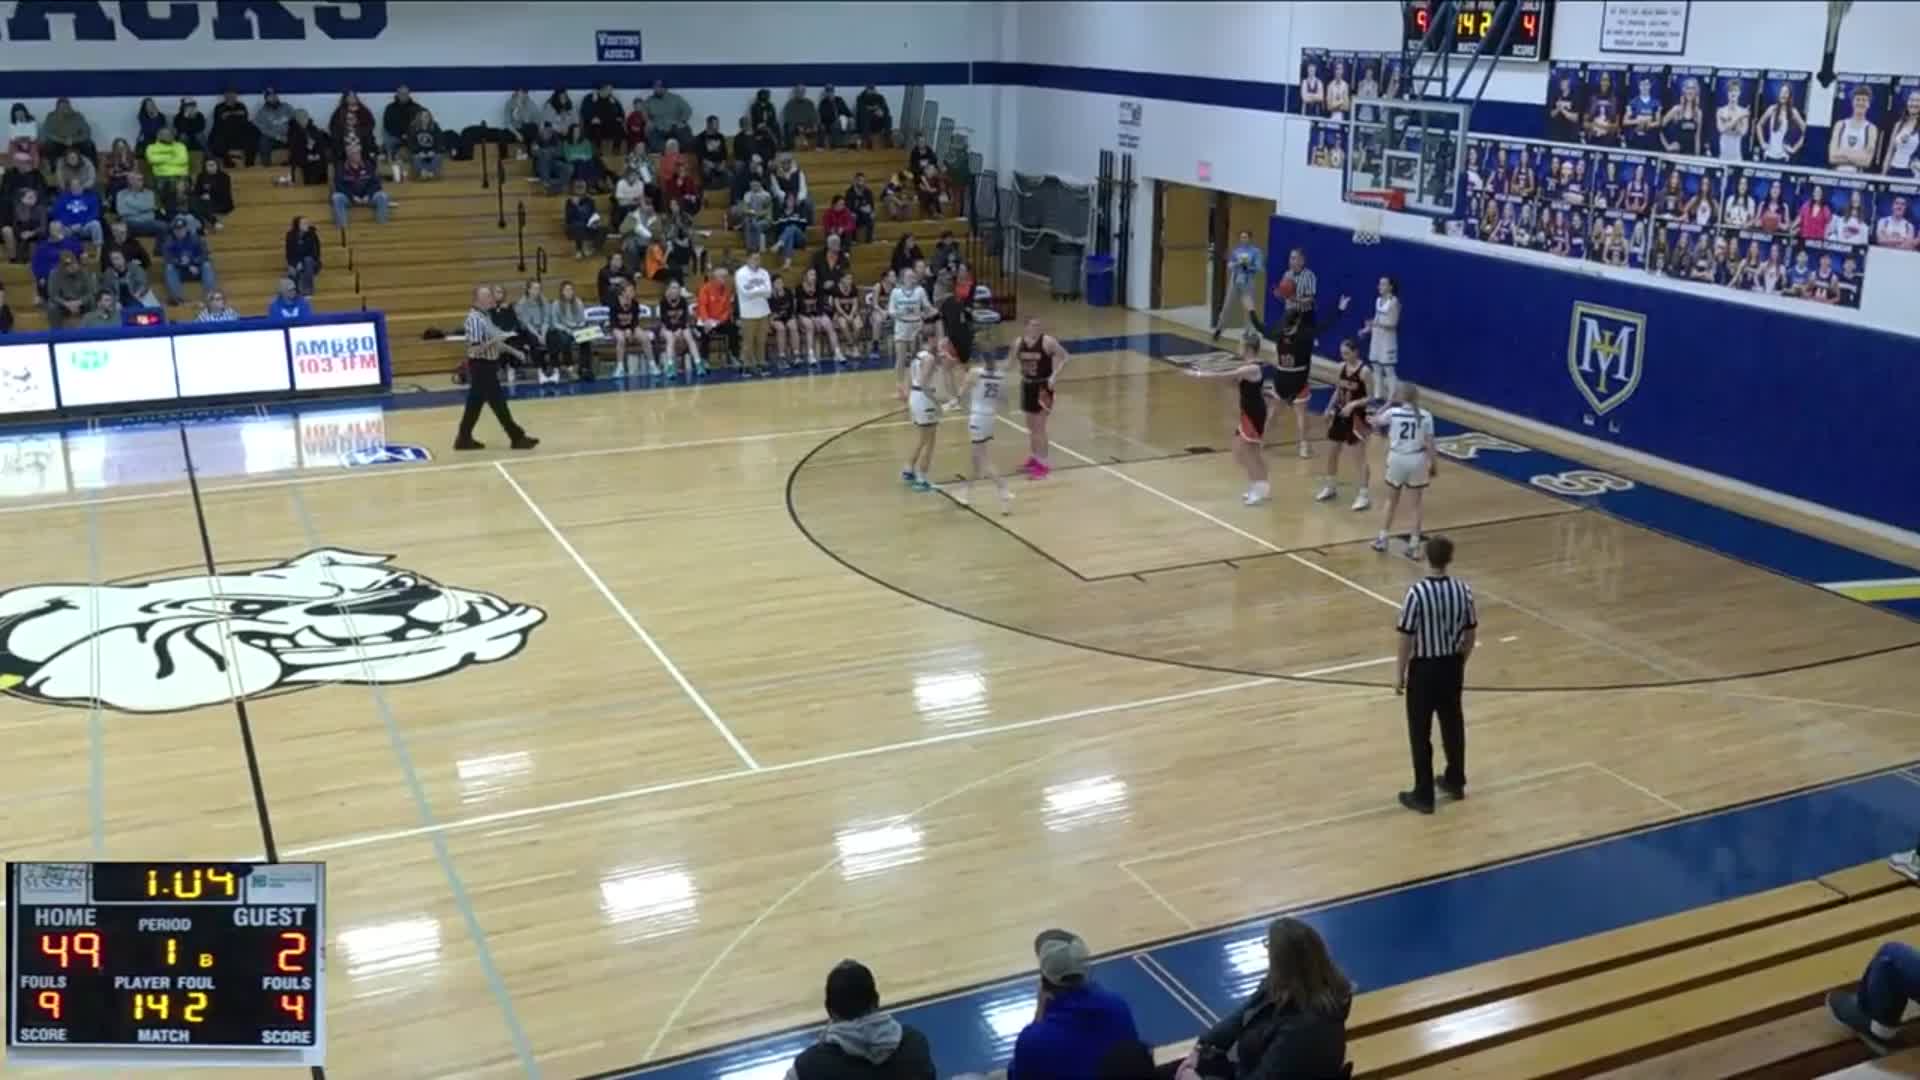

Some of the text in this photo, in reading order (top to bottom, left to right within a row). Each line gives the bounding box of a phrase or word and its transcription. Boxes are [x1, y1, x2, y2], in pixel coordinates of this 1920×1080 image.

[1456, 13, 1474, 35] 14
[1523, 15, 1536, 37] 4
[1512, 44, 1537, 56] SCORE
[1399, 421, 1417, 439] 21
